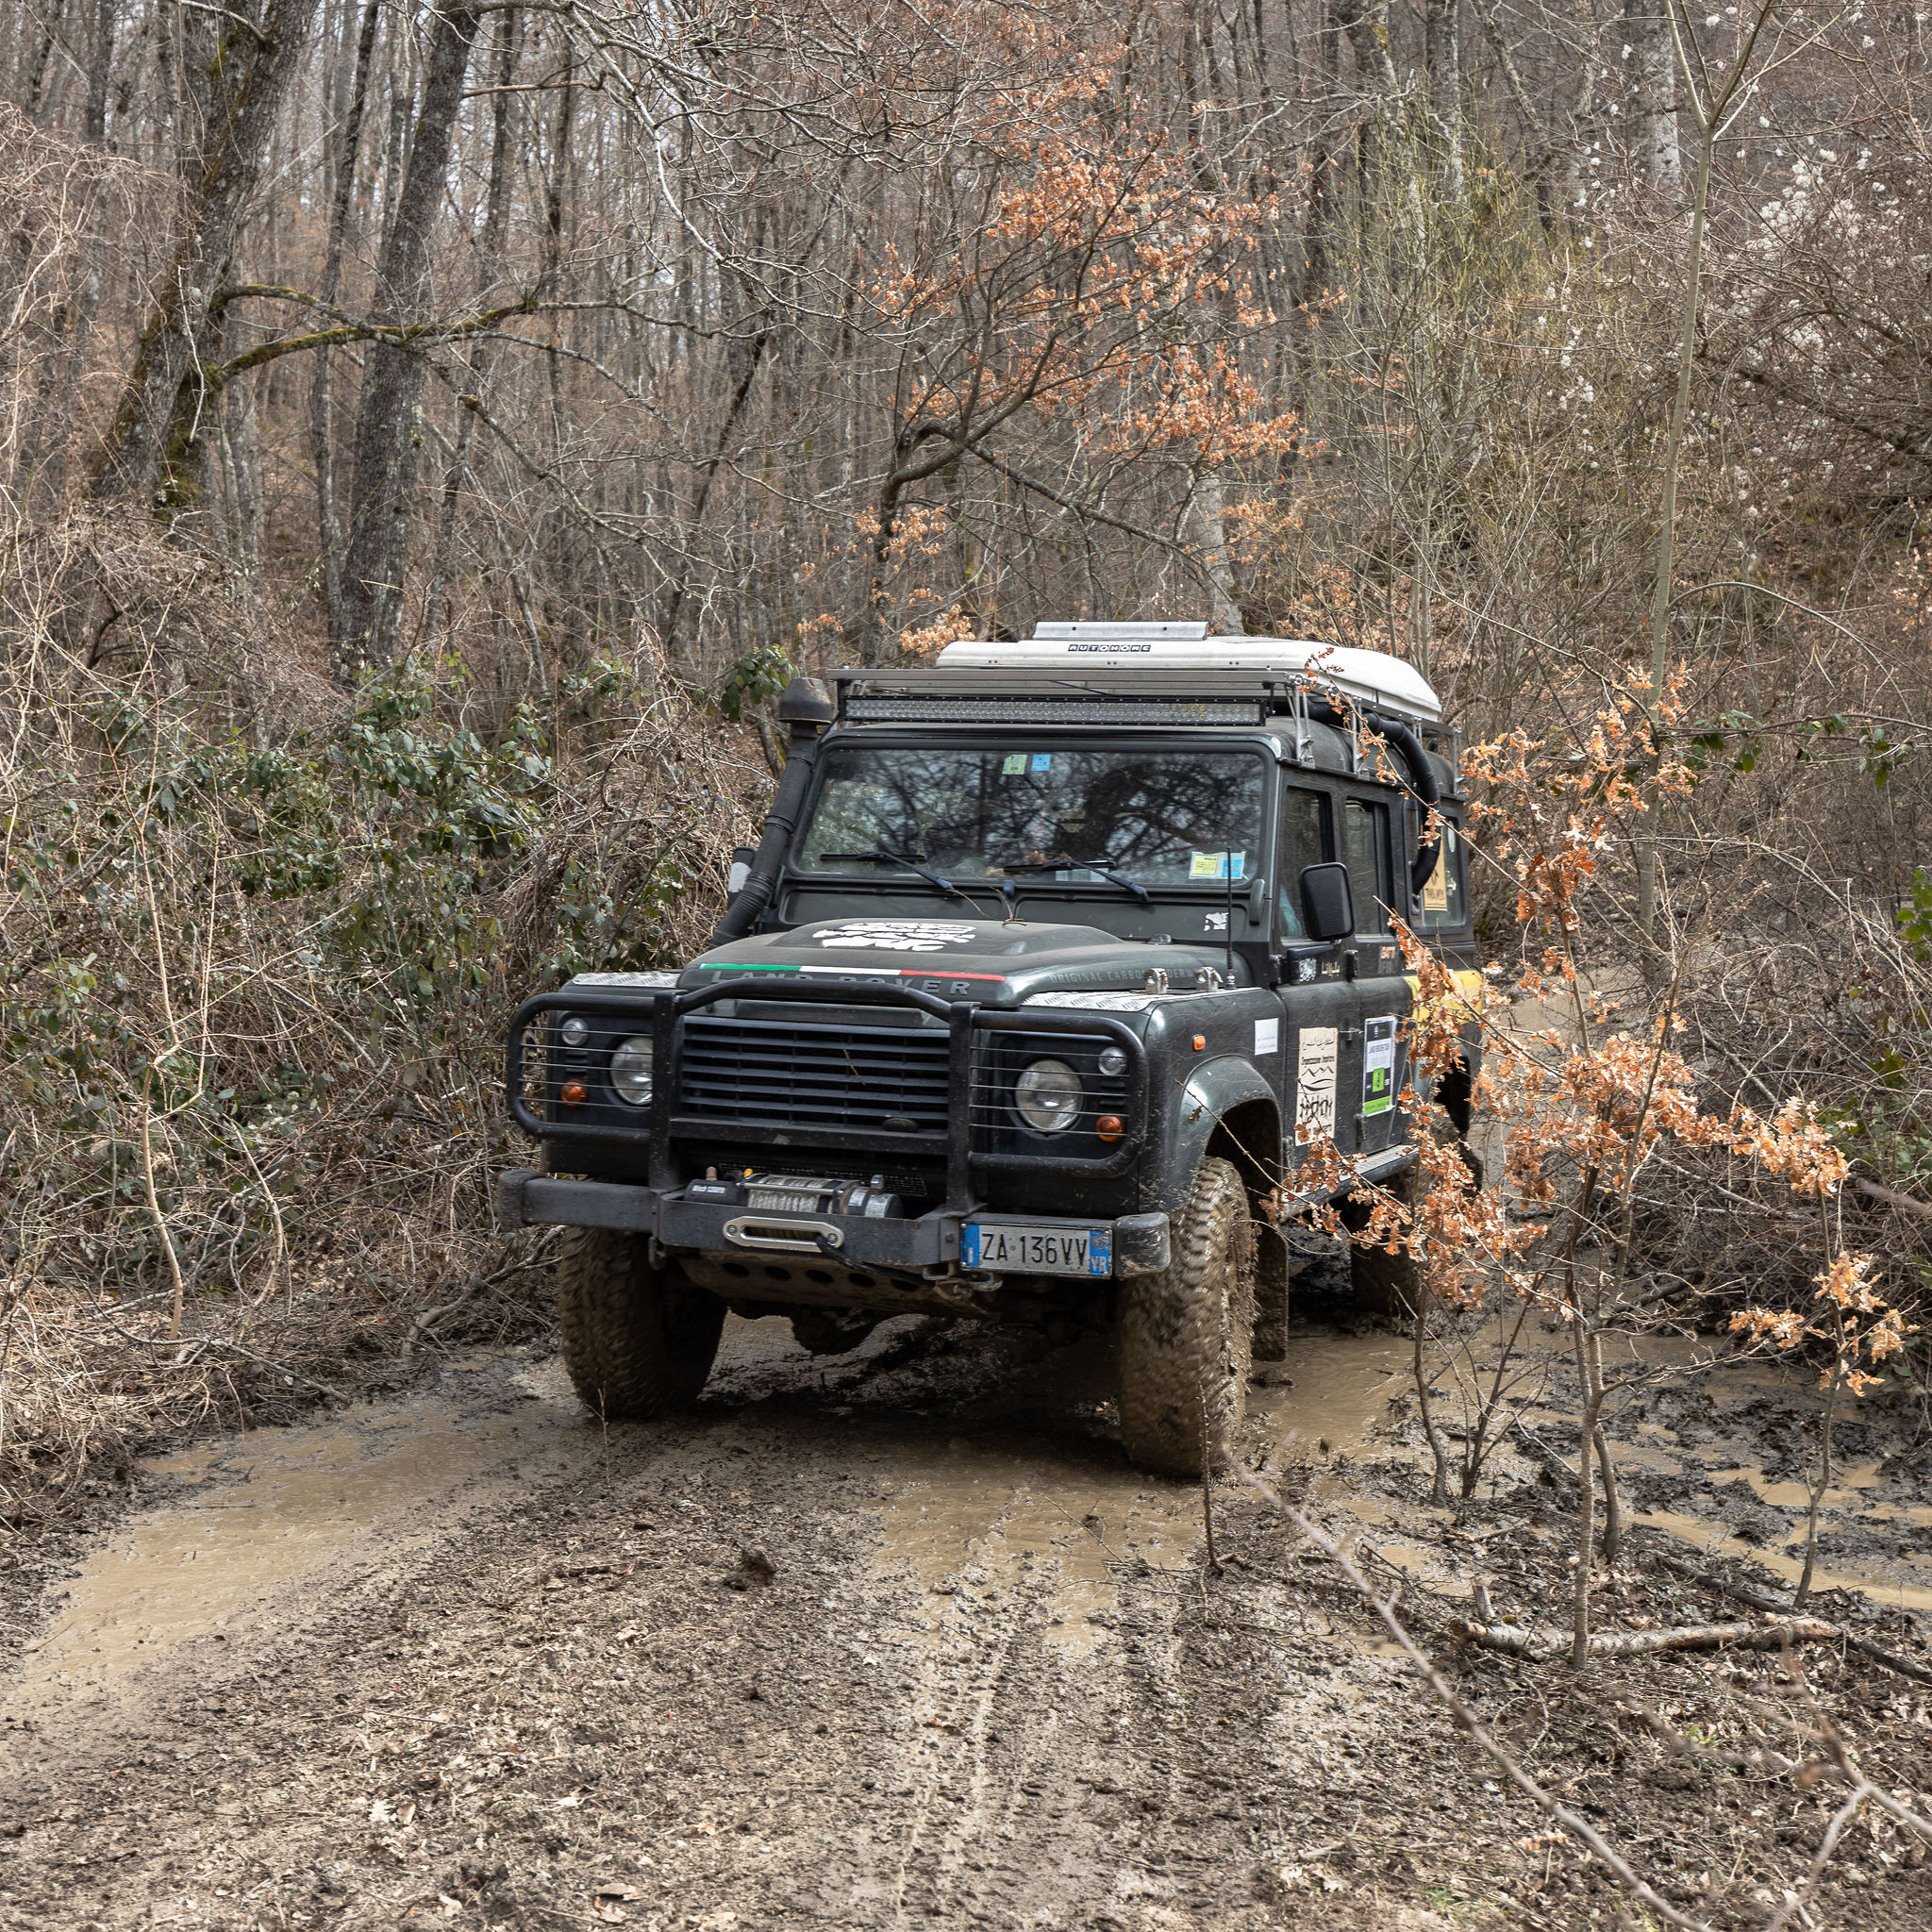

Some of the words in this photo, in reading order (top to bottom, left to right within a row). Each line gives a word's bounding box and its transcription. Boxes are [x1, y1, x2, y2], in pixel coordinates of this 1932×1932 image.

[1049, 971, 1103, 984] ORIGINAL
[982, 1233, 1008, 1261] ZA
[1020, 1235, 1087, 1266] 136VV
[1091, 1256, 1108, 1273] VR
